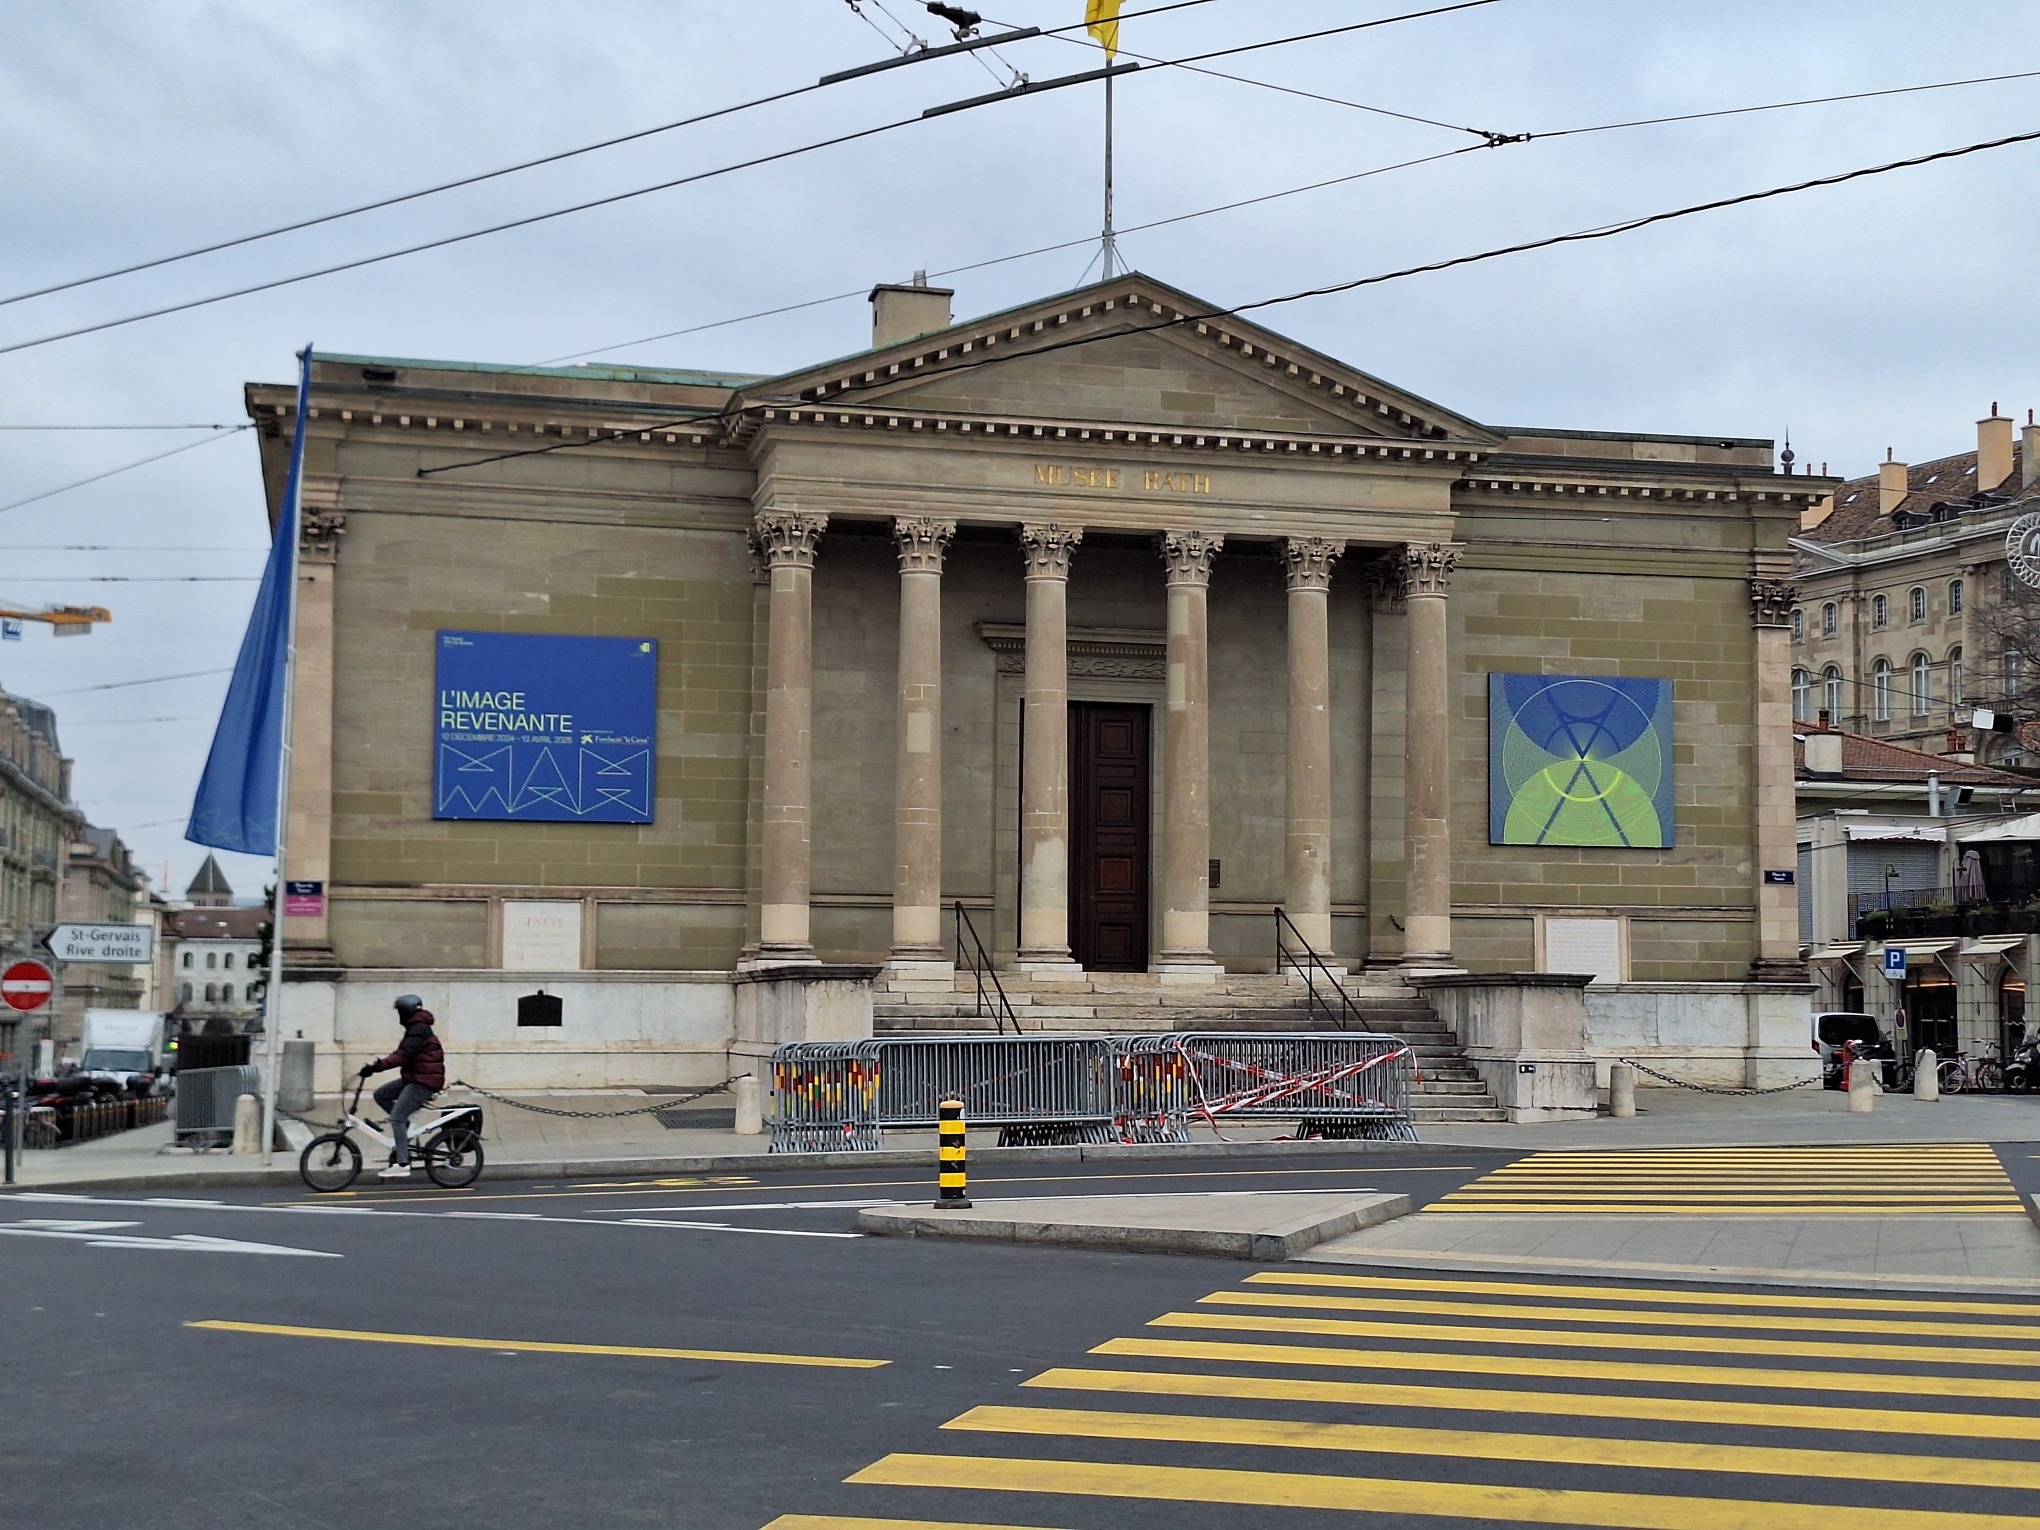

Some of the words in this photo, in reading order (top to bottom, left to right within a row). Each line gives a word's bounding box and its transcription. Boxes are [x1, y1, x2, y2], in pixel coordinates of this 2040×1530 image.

[1144, 469, 1212, 494] RATH
[441, 710, 573, 733] REVENANTE
[70, 928, 142, 943] St-Gervais
[66, 943, 96, 957] Rive
[101, 944, 143, 958] droite
[1889, 951, 1901, 968] P
